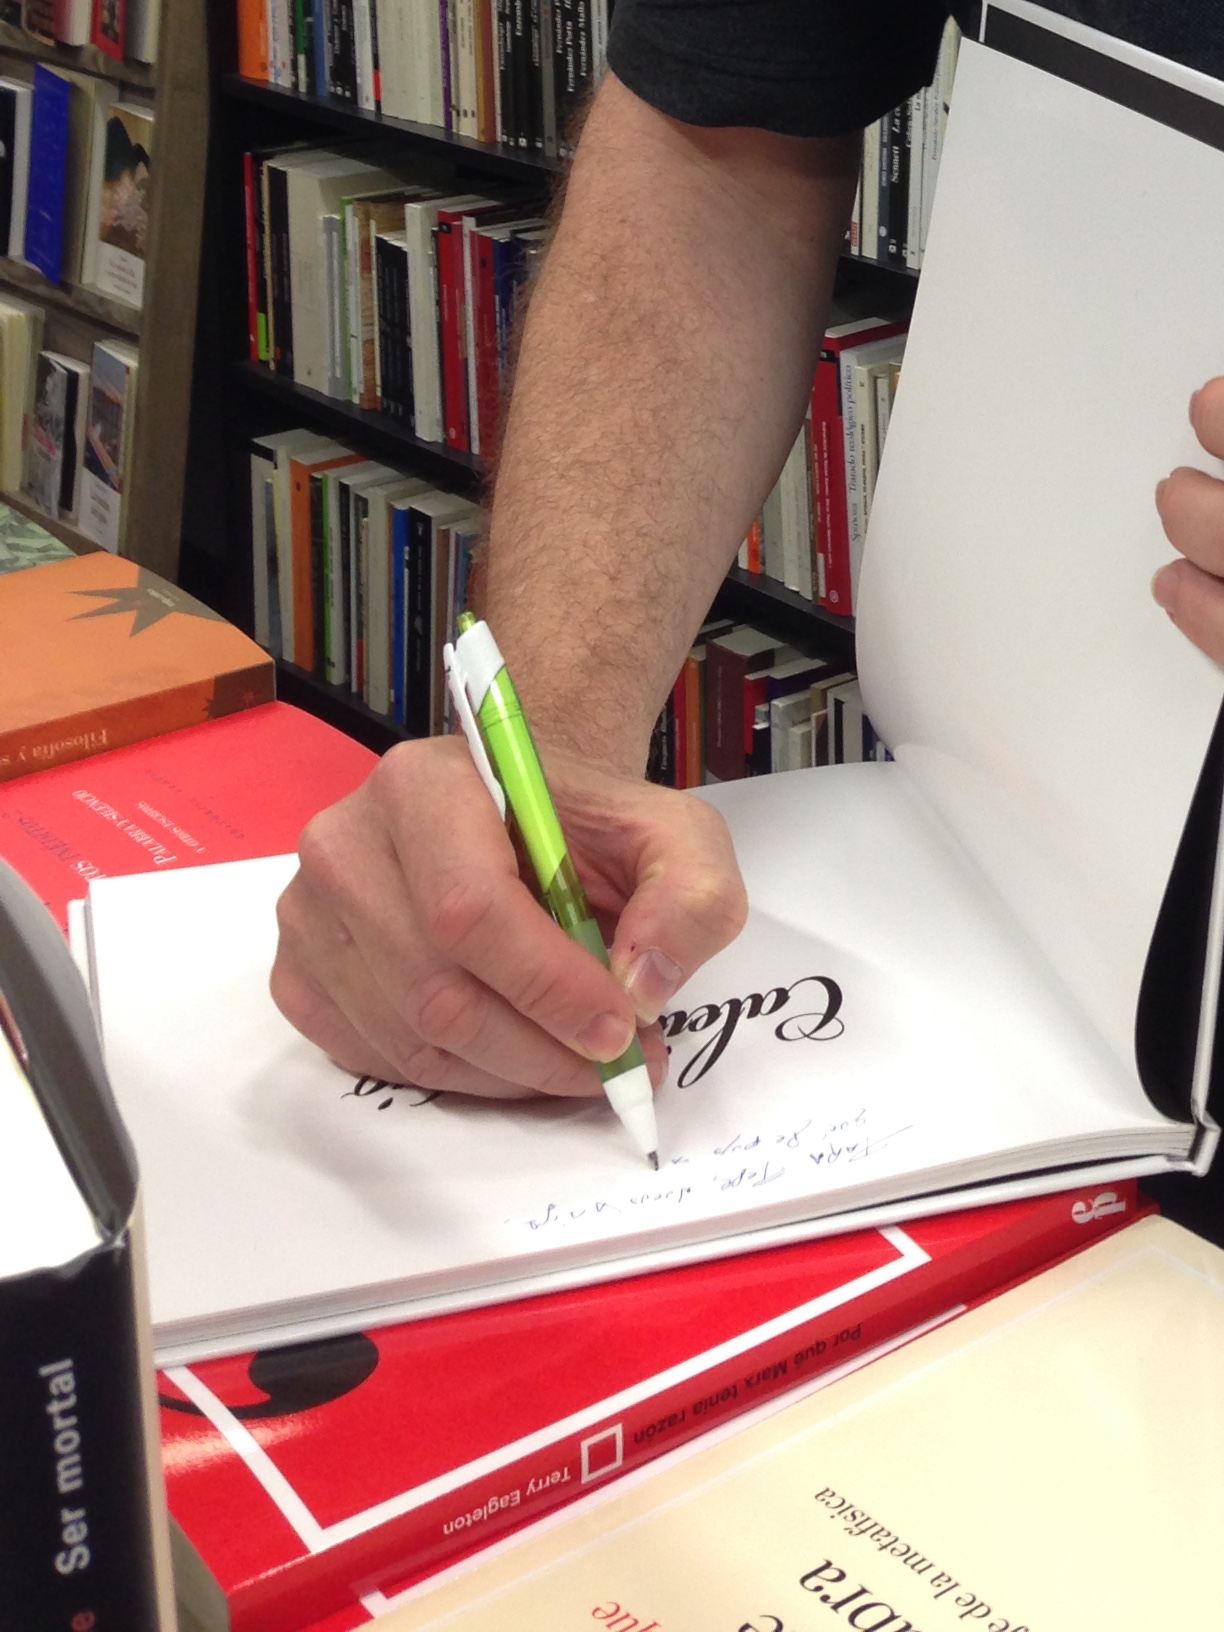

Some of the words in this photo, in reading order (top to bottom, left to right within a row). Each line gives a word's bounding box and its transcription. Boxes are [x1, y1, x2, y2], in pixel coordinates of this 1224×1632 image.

[565, 21, 573, 46] Porta
[844, 364, 856, 404] político
[847, 455, 857, 493] Tratado
[788, 1336, 828, 1368] qué
[831, 1322, 863, 1350] Por
[741, 1354, 790, 1390] Marx
[37, 1358, 84, 1495] mortal
[632, 1405, 688, 1445] razón
[527, 1465, 573, 1496] Terry
[442, 1482, 522, 1538] Eagleton
[54, 1506, 92, 1576] Ser
[813, 1485, 936, 1579] metafísica
[927, 1570, 961, 1601] la
[951, 1591, 992, 1621] de
